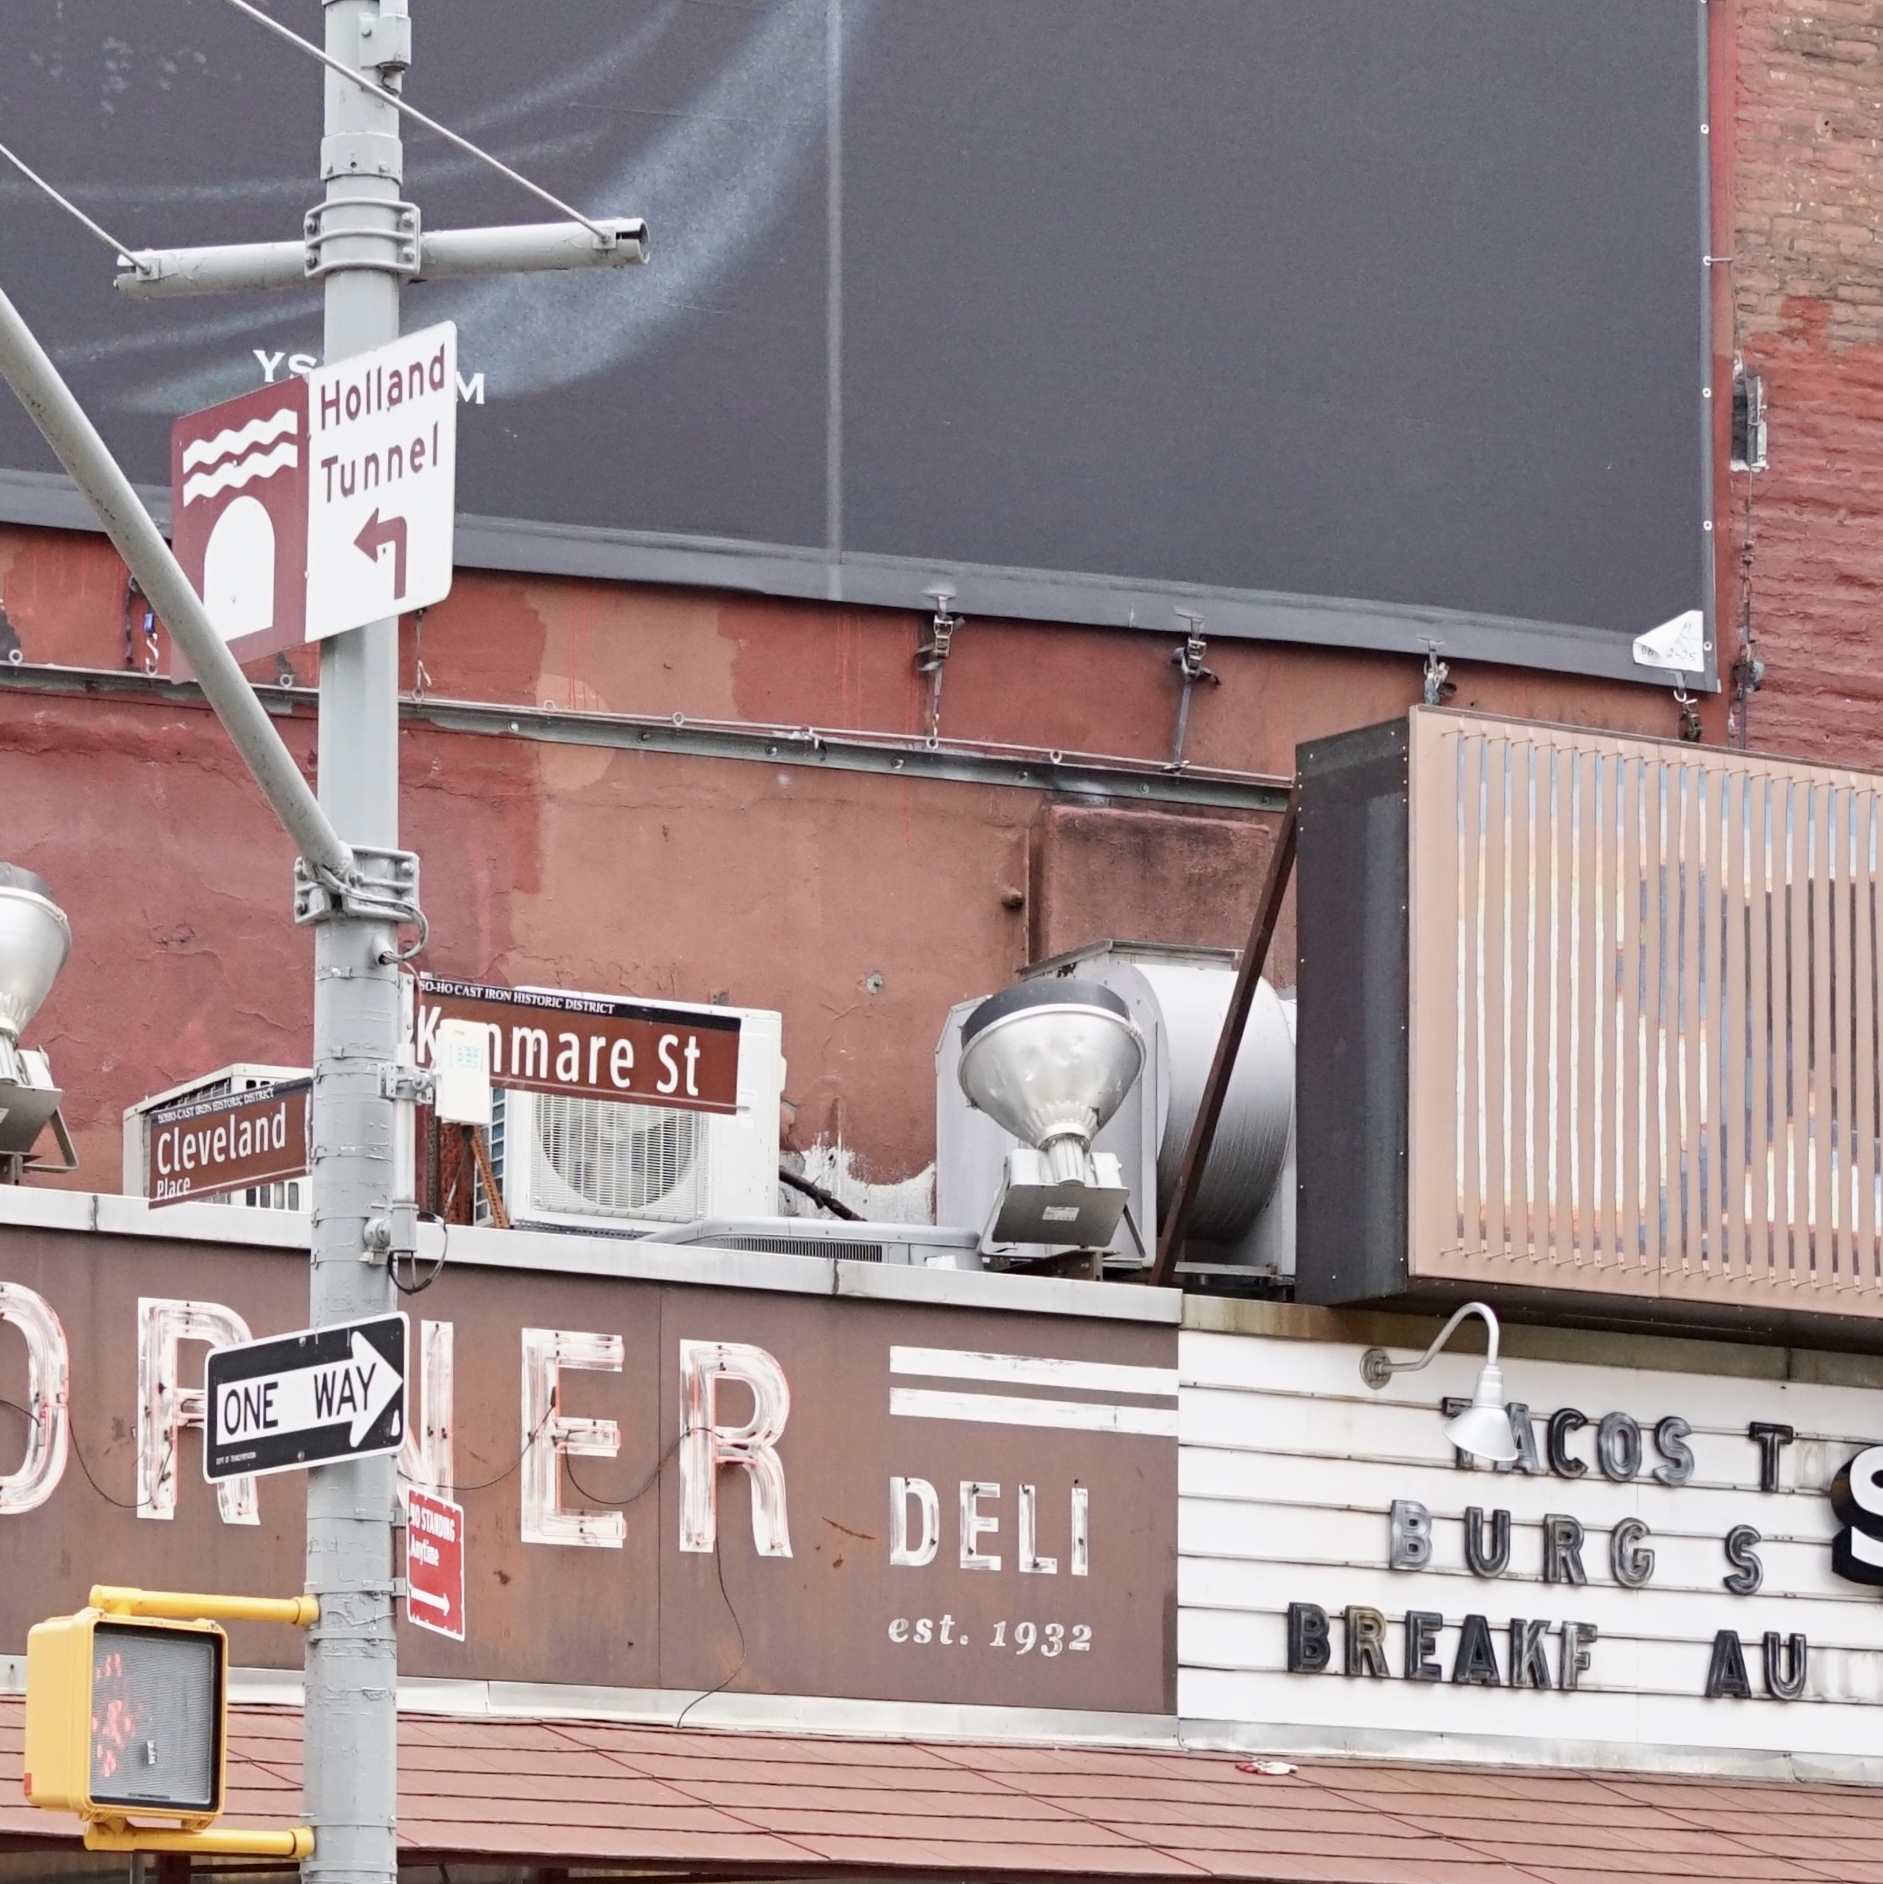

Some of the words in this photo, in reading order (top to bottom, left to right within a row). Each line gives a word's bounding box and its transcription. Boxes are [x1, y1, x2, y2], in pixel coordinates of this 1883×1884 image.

[321, 341, 445, 431] Holland
[321, 421, 438, 504] Tunnel
[454, 983, 483, 998] CAST
[484, 986, 512, 1002] IRON
[513, 990, 564, 1009] HISTORIC
[565, 996, 615, 1014] DISTRICT
[417, 1005, 634, 1089] Knmare
[655, 1034, 701, 1096] St
[157, 1102, 286, 1175] Cleveland
[157, 1177, 191, 1200] Place
[224, 1381, 279, 1436] ONE
[313, 1362, 377, 1420] WAY
[410, 1502, 421, 1528] NO
[421, 1507, 456, 1543] STANDING
[410, 1533, 440, 1566] Anytime
[890, 1476, 1089, 1577] DELI
[888, 1614, 969, 1645] est.
[989, 1620, 1093, 1657] 1932
[1287, 1602, 1598, 1690] BREAKF
[1705, 1629, 1807, 1700] AU
